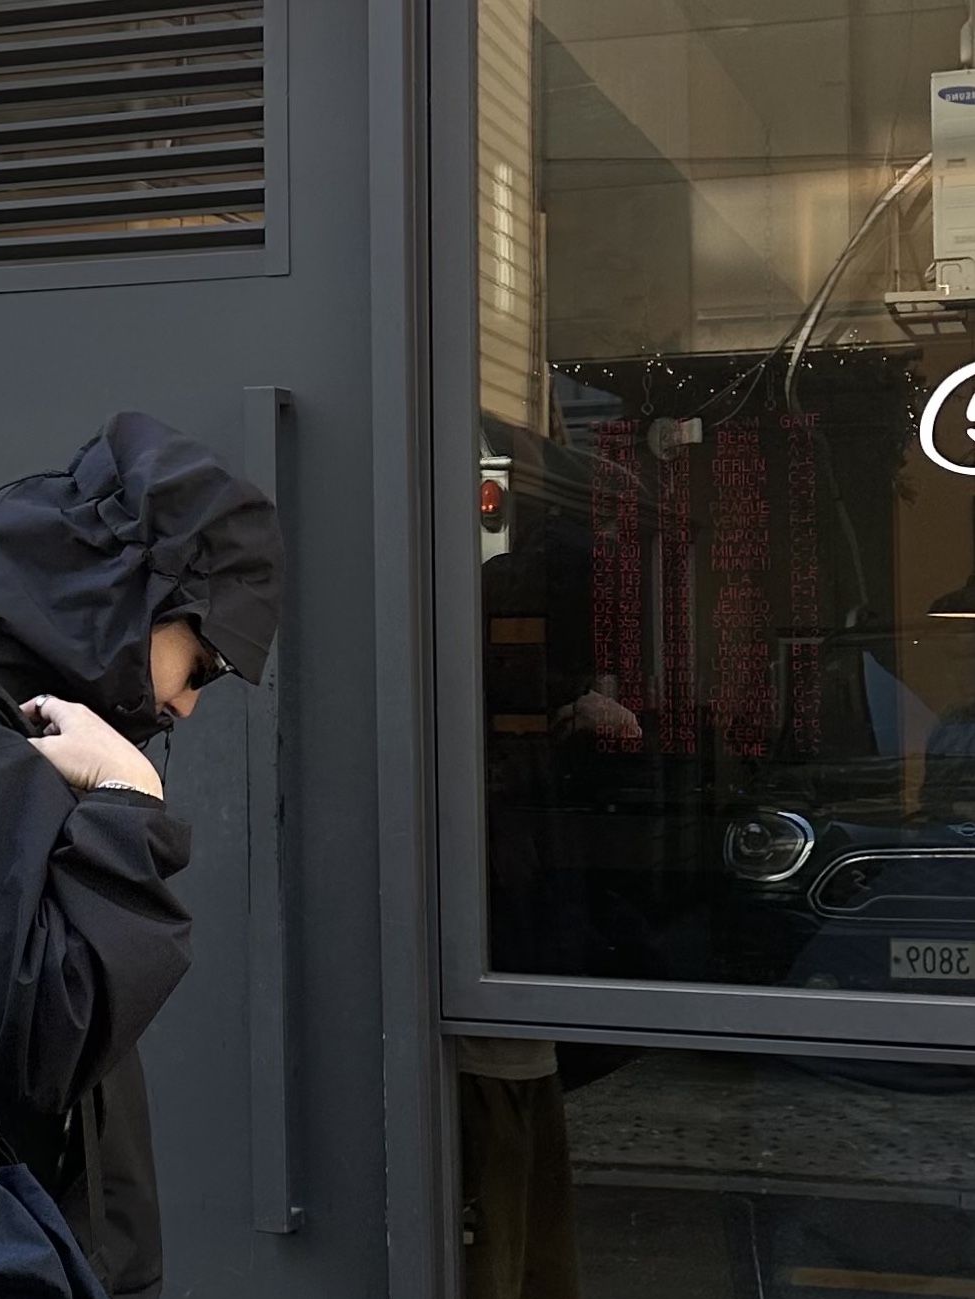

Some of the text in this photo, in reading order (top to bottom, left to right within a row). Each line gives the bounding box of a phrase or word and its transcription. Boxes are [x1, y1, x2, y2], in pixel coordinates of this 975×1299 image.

[712, 459, 765, 472] BERLIN
[709, 502, 770, 515] PRAGUE
[713, 516, 769, 529] VENICE
[593, 546, 613, 558] MU
[712, 544, 769, 557] MILANO
[593, 560, 613, 572] OZ
[712, 558, 771, 571] MUNICH
[594, 601, 614, 614] OZ
[712, 615, 773, 628] SYDNEY
[710, 686, 777, 699] CHICAGO
[708, 700, 781, 713] TORONTO
[724, 728, 765, 741] CEBU
[723, 743, 768, 756] HOME
